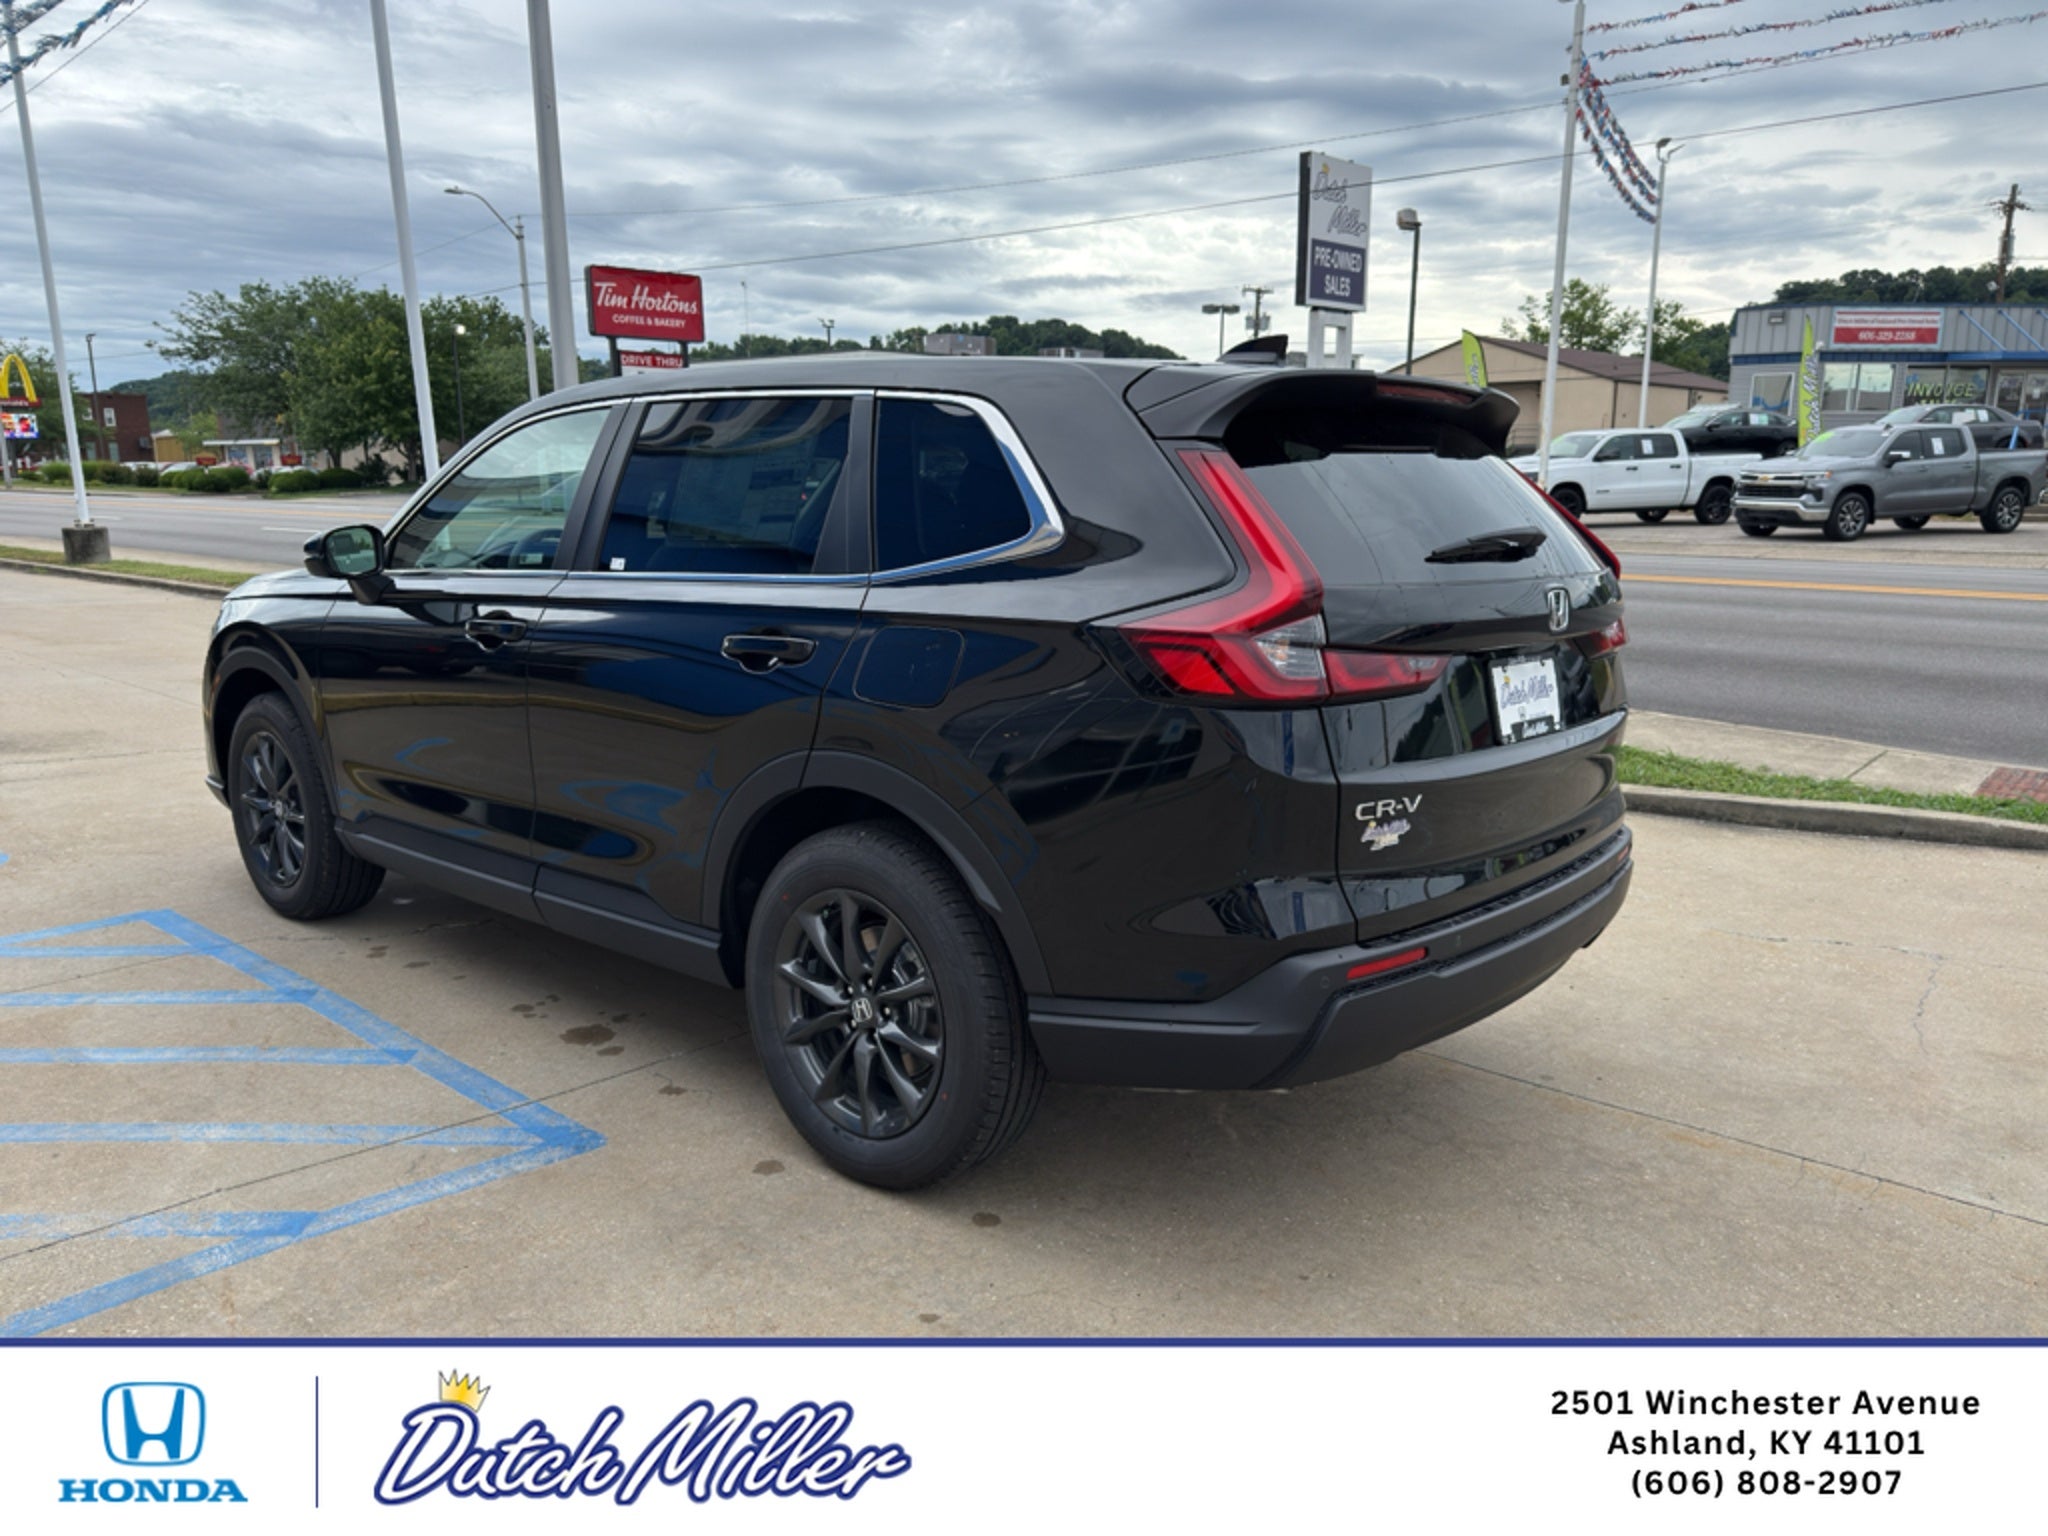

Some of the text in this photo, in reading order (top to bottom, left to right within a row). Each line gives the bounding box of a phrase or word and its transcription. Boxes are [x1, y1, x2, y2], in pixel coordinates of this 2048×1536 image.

[1314, 246, 1362, 273] PRE-OWNED
[593, 281, 699, 315] Tim Hortons
[1324, 274, 1351, 297] SALES
[612, 313, 645, 325] COFFEE
[654, 317, 687, 329] BAKERY
[621, 354, 683, 368] DRIVE THRU
[1354, 793, 1423, 821] CR-V
